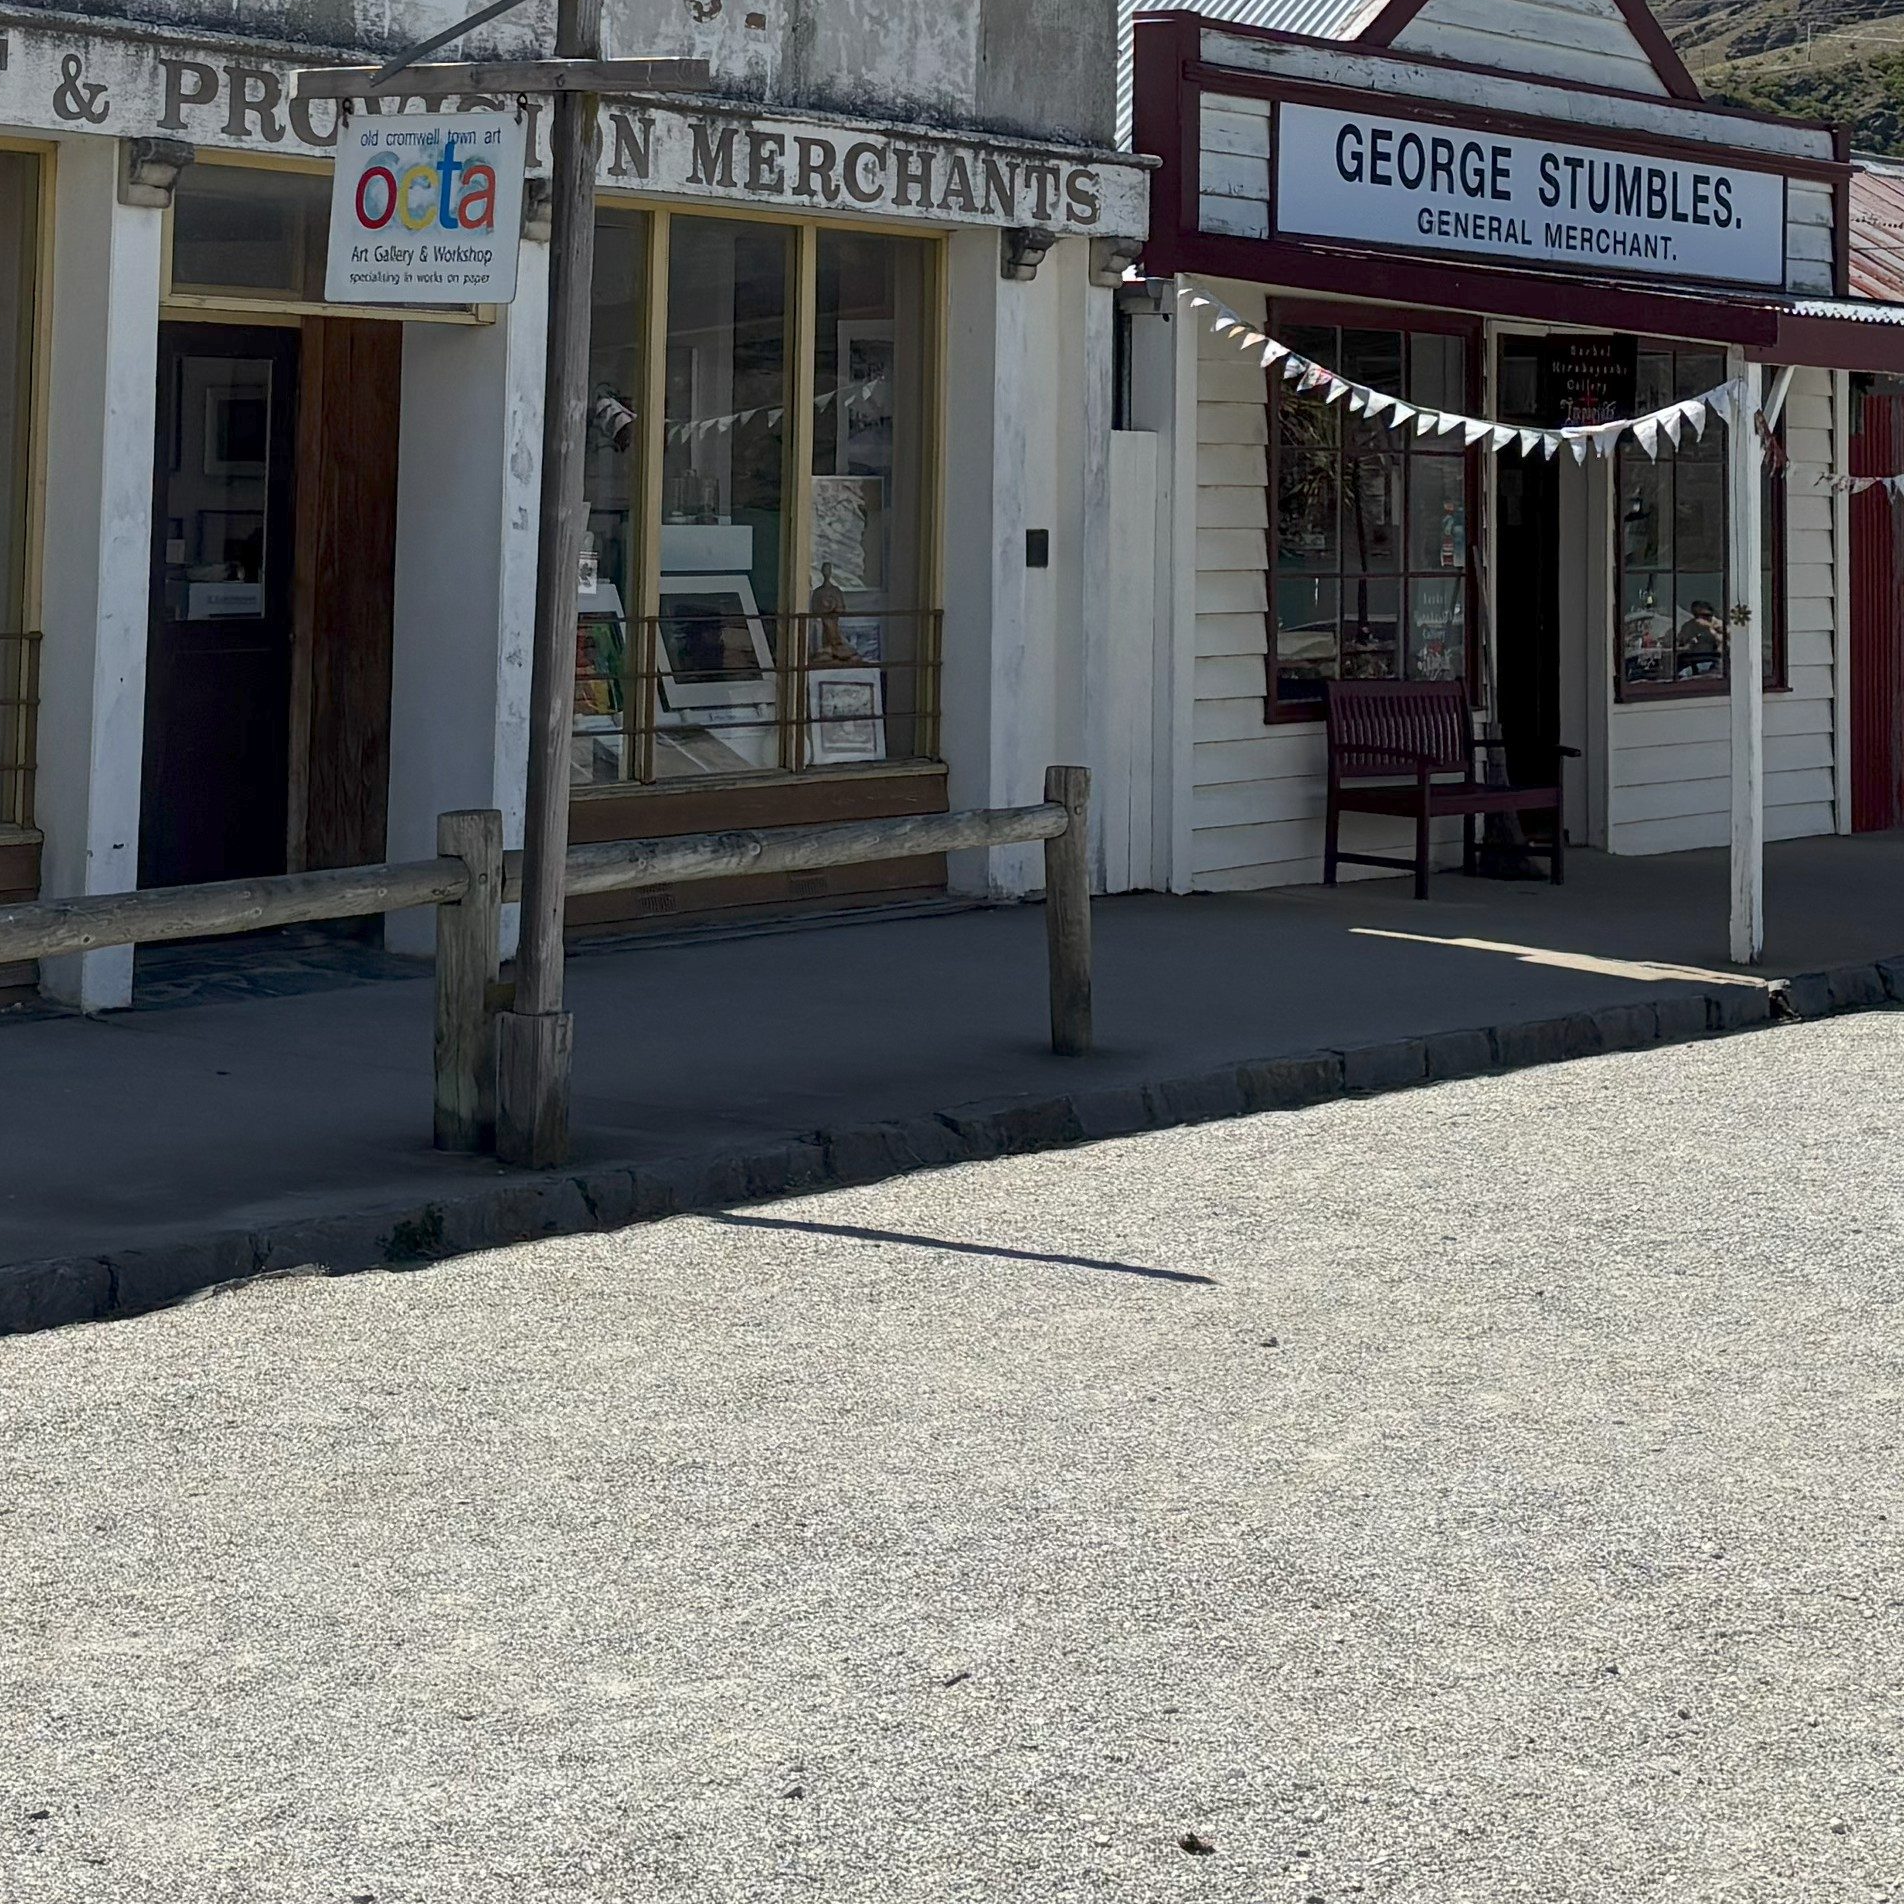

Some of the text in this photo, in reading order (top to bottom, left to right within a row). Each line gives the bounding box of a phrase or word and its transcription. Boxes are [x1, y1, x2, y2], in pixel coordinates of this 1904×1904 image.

[52, 52, 111, 126] &
[686, 125, 1098, 224] MERCHANTS
[360, 128, 502, 147] old cromwell town art
[355, 142, 497, 230] octa
[1335, 124, 1743, 230] GEORGE STUMBLES.
[351, 245, 493, 266] Art Gallery & Workshop
[1416, 207, 1678, 261] GENERAL MERCHANT.
[404, 272, 413, 283] in
[417, 272, 443, 283] works
[447, 274, 459, 283] on
[463, 273, 490, 285] paper
